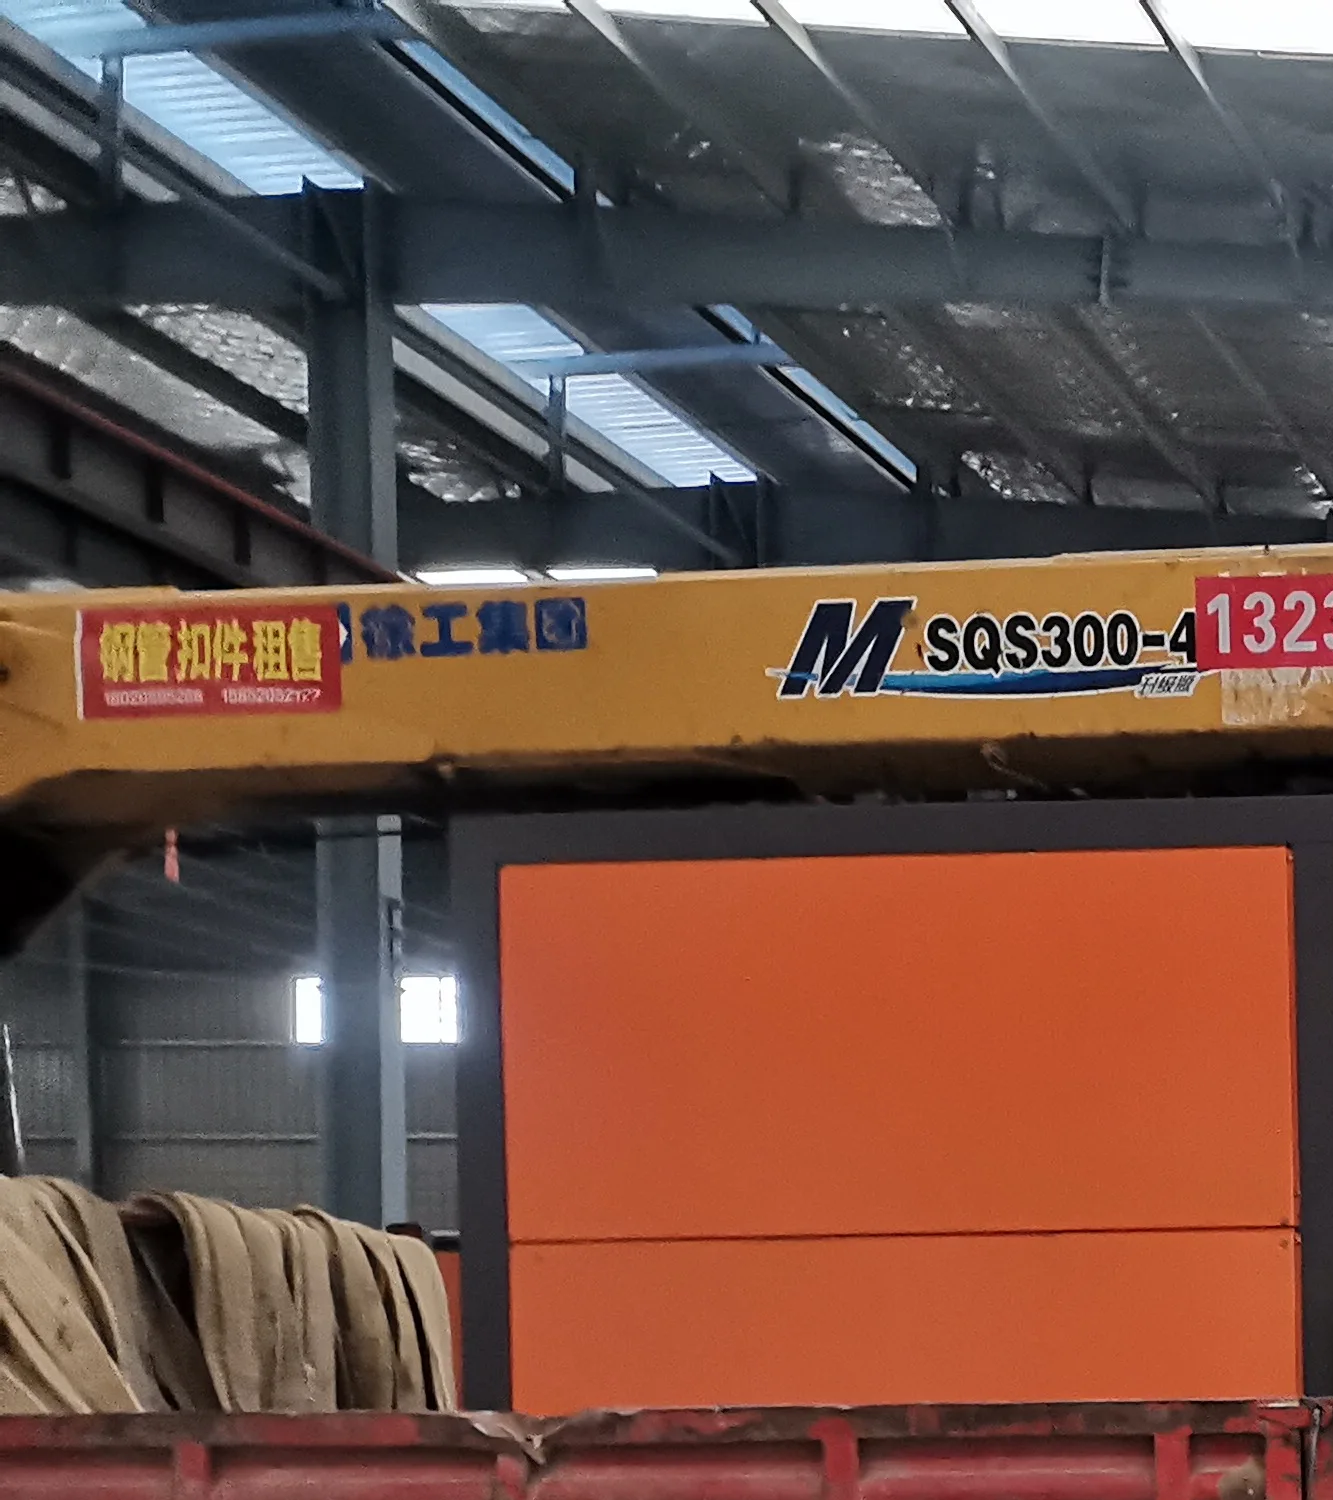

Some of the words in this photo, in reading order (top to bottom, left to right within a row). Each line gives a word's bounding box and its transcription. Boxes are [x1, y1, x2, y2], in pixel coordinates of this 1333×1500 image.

[360, 597, 588, 660] 徐工集团
[926, 611, 1196, 669] SQS300-4
